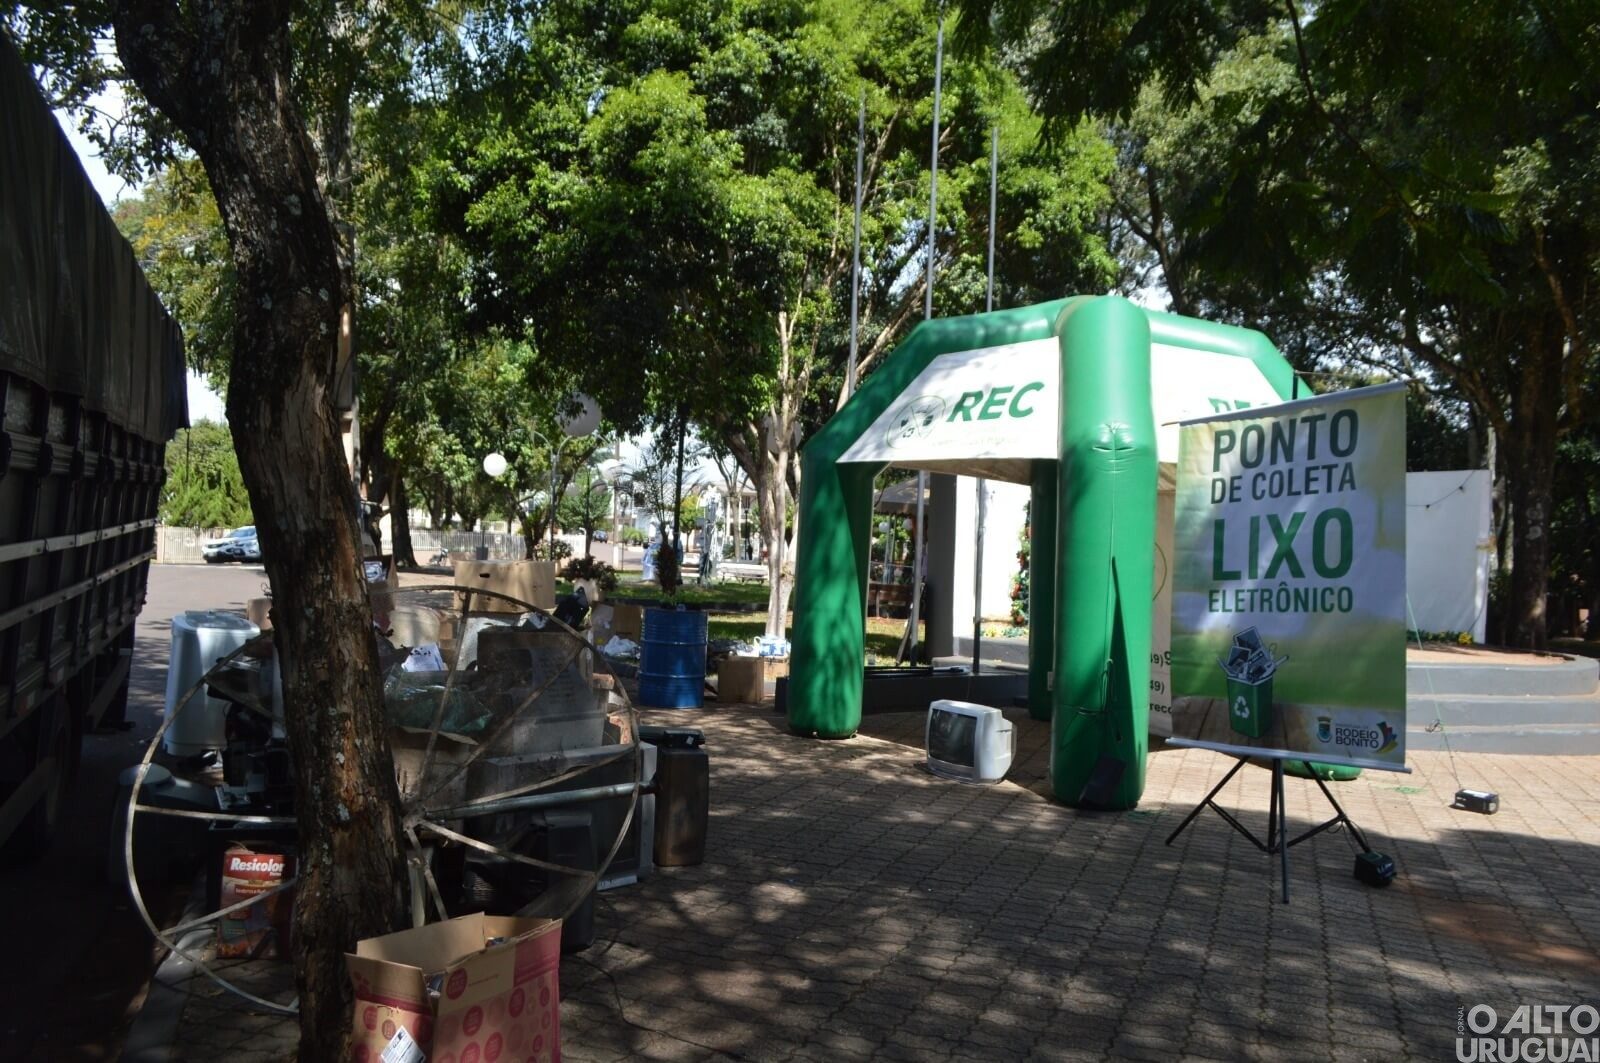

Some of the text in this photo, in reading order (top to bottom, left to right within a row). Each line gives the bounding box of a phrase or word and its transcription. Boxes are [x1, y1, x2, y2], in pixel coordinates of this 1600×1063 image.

[945, 381, 1045, 422] REC
[1212, 408, 1359, 473] PONTO
[1210, 462, 1356, 504] DE COLETA
[1212, 508, 1354, 581] LIXO
[1208, 581, 1353, 613] ELETRÔNICO
[1335, 727, 1379, 740] RODEIO
[1335, 736, 1379, 749] BONITO
[230, 857, 286, 873] Resicolor
